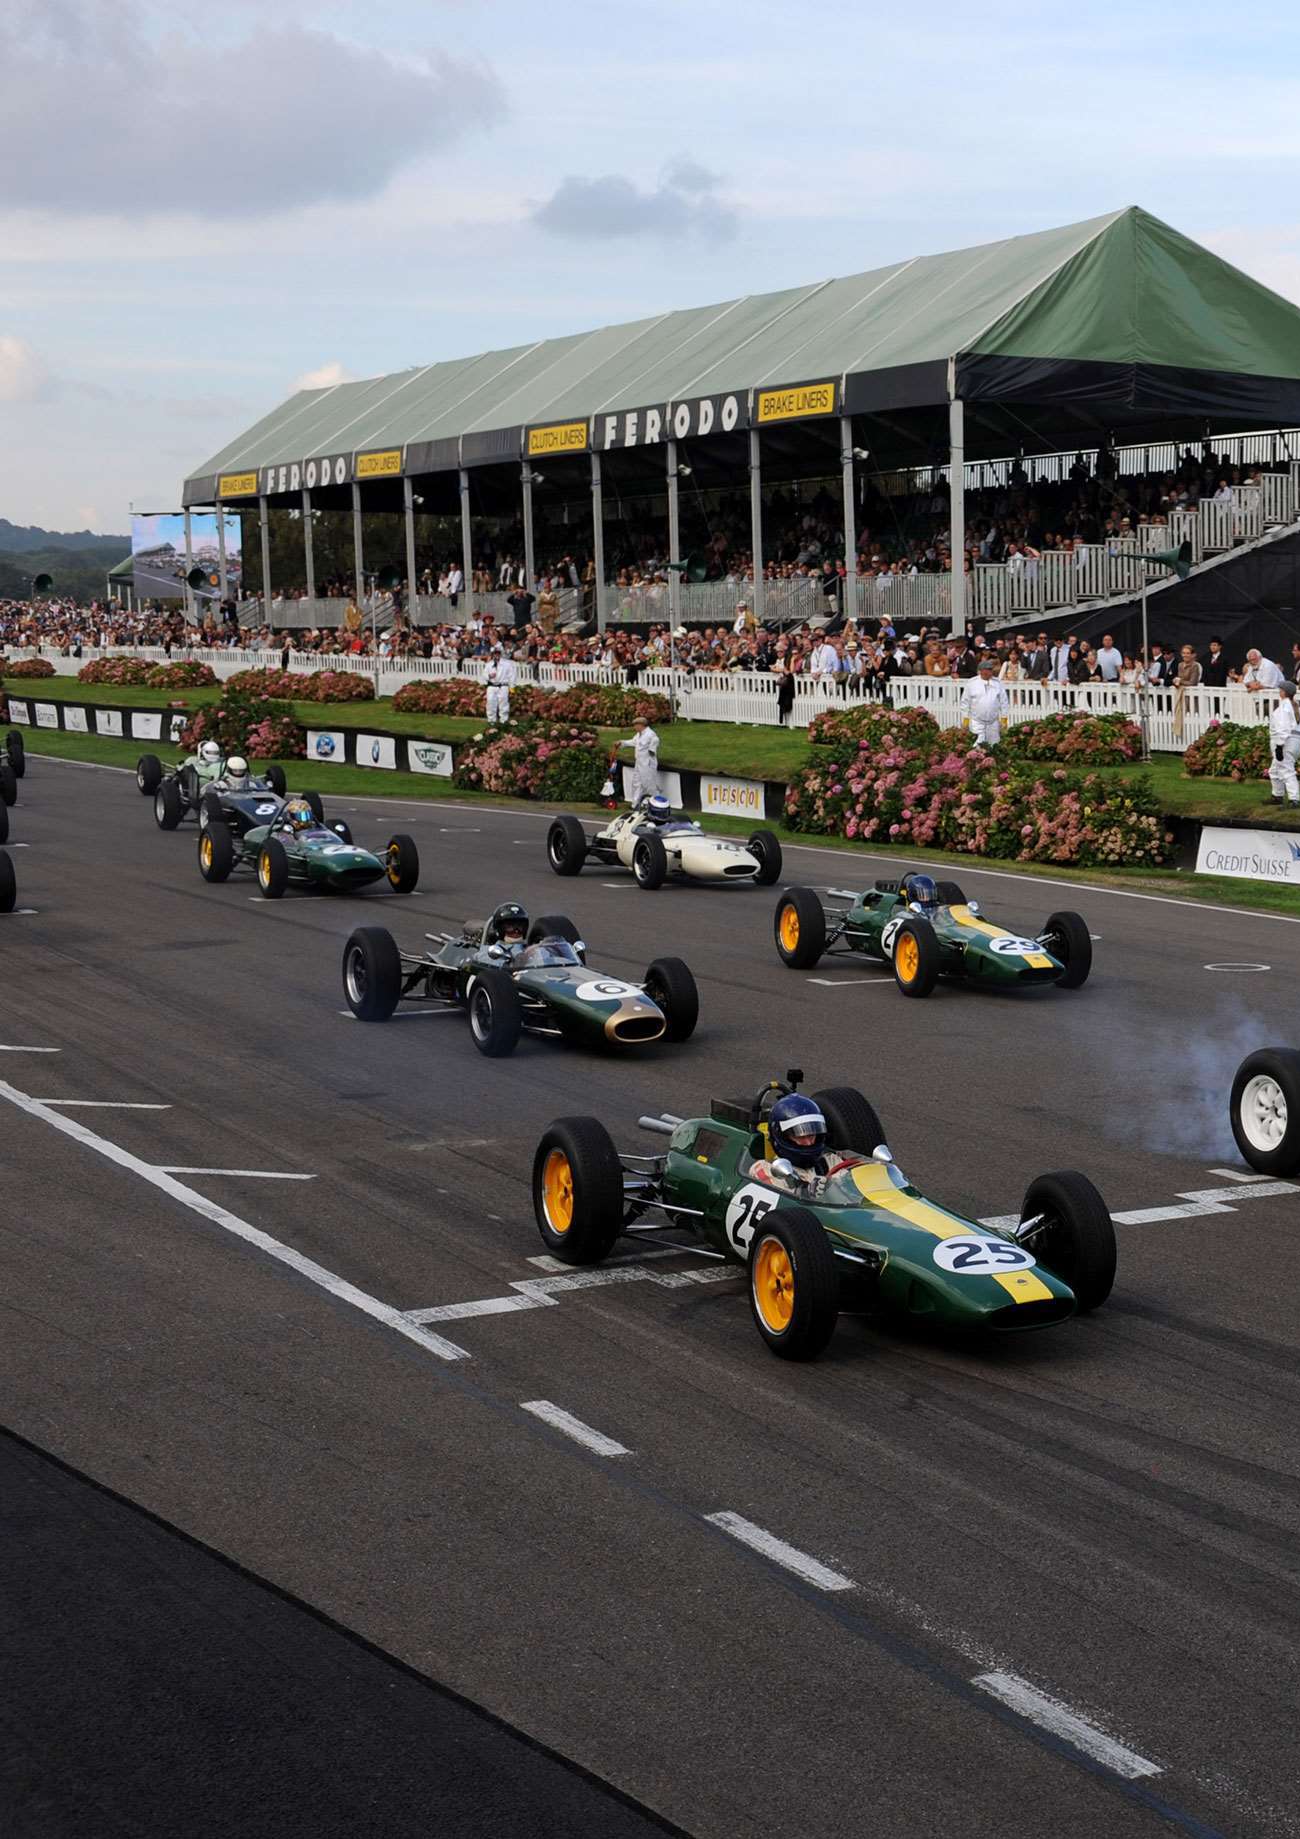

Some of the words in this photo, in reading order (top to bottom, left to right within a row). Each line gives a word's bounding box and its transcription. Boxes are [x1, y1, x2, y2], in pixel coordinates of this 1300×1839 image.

[763, 393, 794, 415] BRAKE
[796, 389, 829, 408] LINERS
[604, 395, 739, 450] FERODO
[531, 433, 558, 450] CLUTCH
[559, 428, 585, 447] LINERS
[266, 457, 346, 495] FERODO
[712, 786, 755, 806] TESCO
[255, 803, 277, 816] 8
[1206, 850, 1250, 873] CREDIT
[1251, 854, 1291, 877] SUISSE
[884, 921, 900, 950] 2
[594, 982, 627, 995] 6
[945, 1242, 1027, 1269] 25
